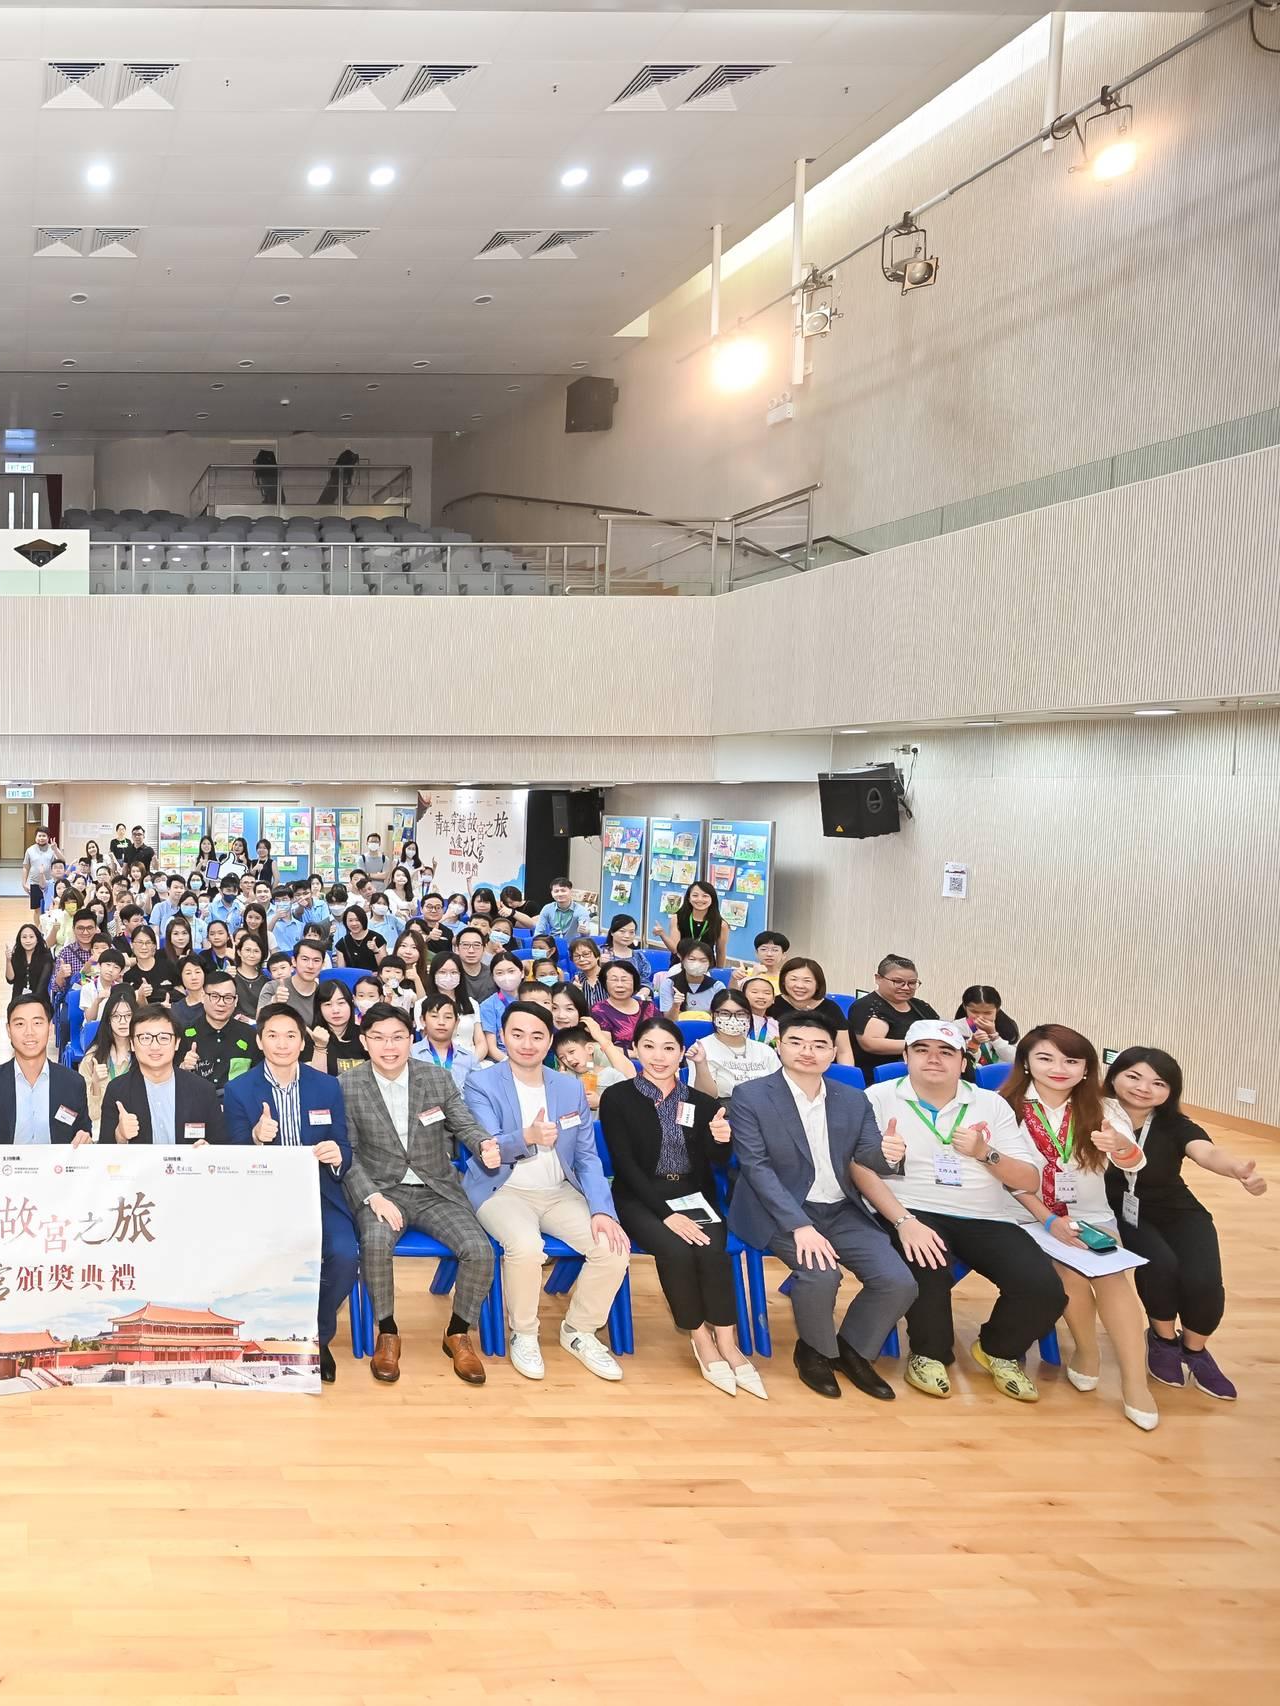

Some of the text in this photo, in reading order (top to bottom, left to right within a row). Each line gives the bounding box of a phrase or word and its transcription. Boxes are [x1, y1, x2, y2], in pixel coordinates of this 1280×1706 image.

[435, 811, 508, 840] 青年穿越故宮之旅
